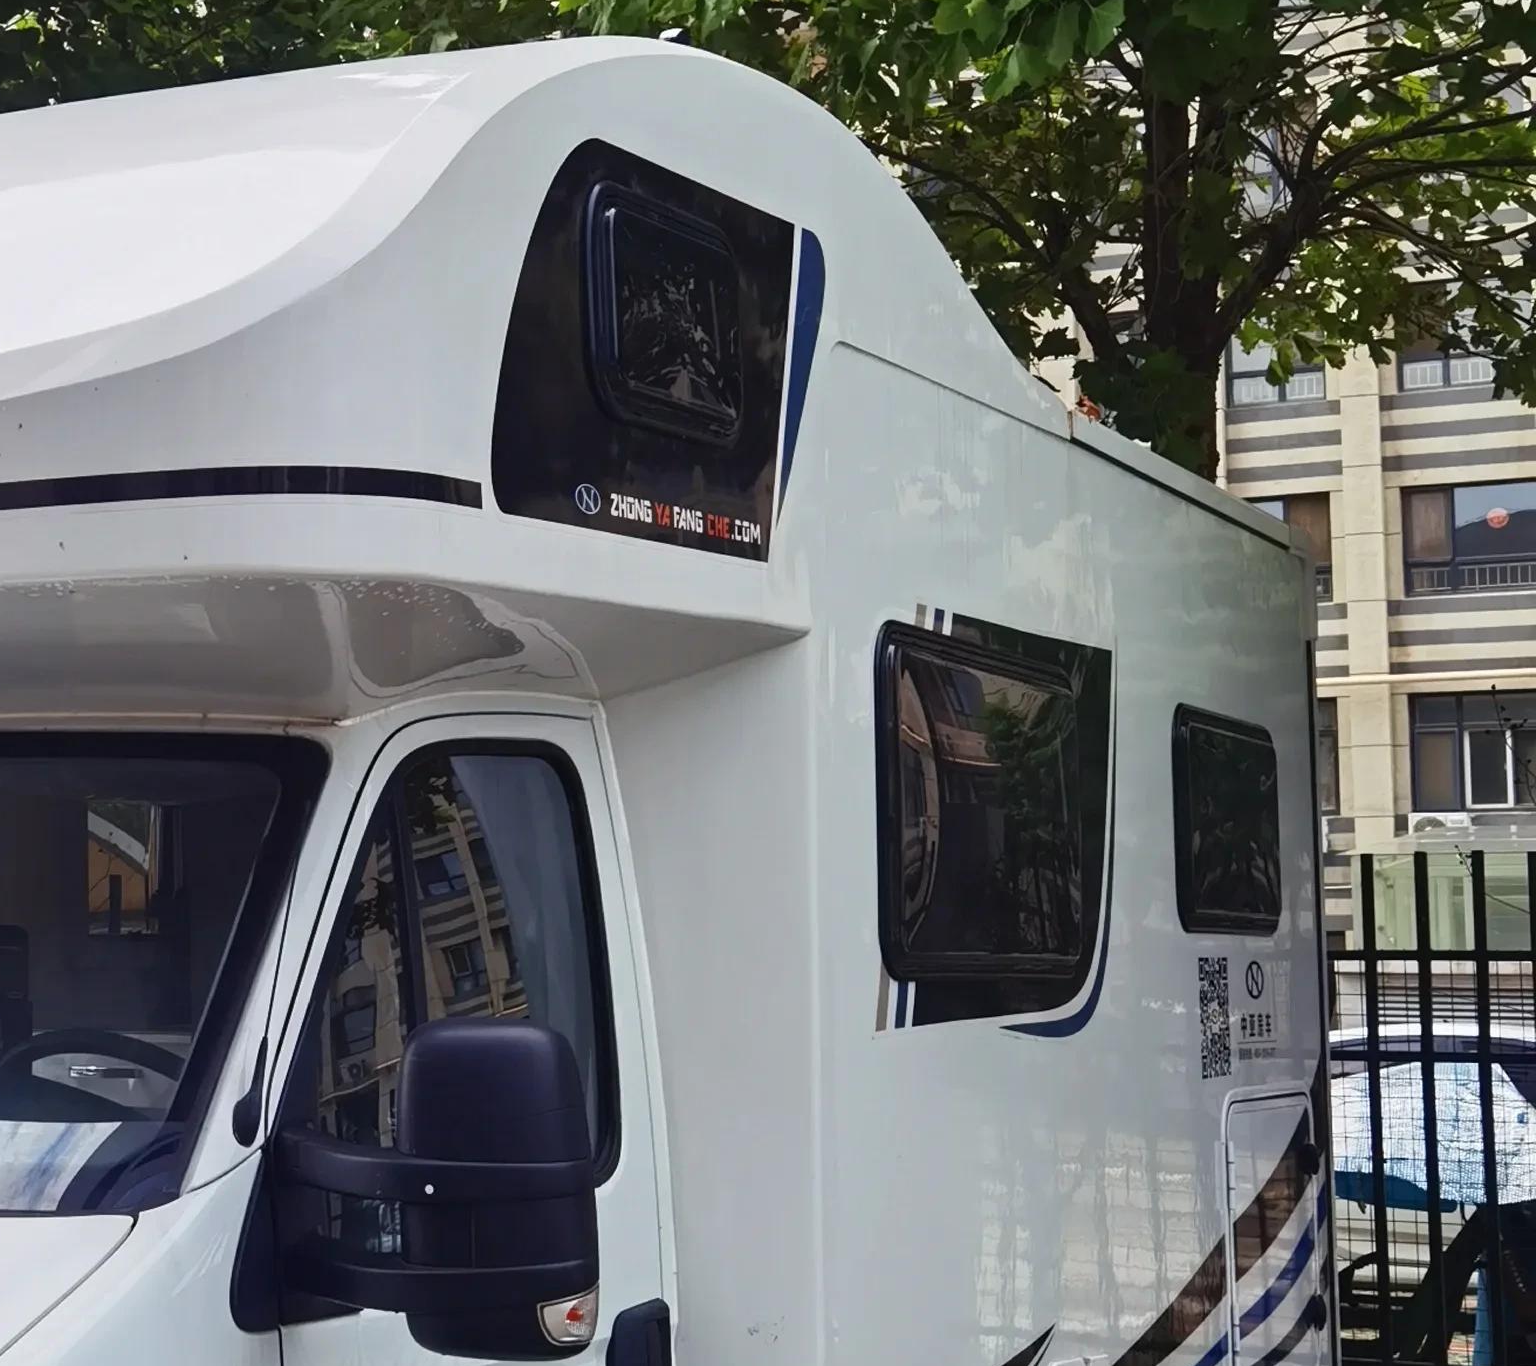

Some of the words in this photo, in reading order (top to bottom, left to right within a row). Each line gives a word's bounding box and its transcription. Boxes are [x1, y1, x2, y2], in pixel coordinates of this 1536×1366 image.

[610, 493, 653, 523] ZHONG
[654, 502, 671, 528] YA
[673, 505, 704, 533] FANG
